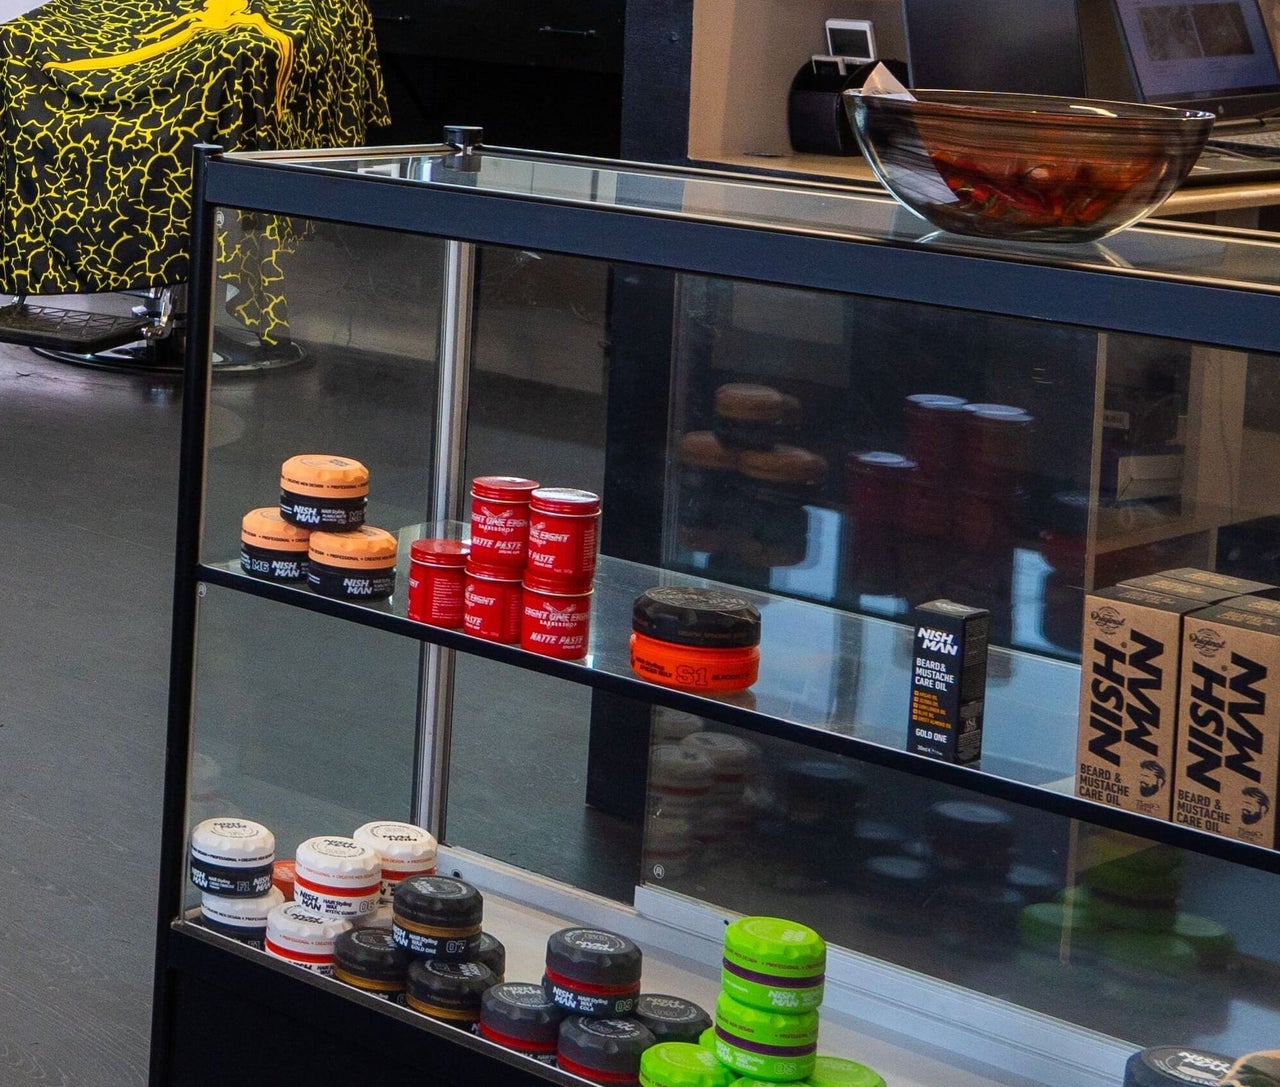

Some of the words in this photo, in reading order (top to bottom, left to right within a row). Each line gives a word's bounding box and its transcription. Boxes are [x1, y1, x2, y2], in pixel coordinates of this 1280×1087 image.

[293, 505, 317, 515] NISH
[296, 514, 320, 524] MAN
[486, 517, 506, 527] ONE
[540, 531, 570, 542] EIGHT
[495, 540, 521, 550] PASTE
[271, 560, 297, 571] NISH
[532, 552, 556, 564] PASTE
[275, 569, 300, 577] MAN
[344, 578, 369, 588] NISH
[347, 585, 372, 595] MAN
[525, 606, 549, 620] EIGHT
[549, 613, 570, 622] ONE
[1091, 611, 1127, 626] Original
[539, 619, 577, 627] BARBERSHOP
[530, 632, 558, 644] MATTE
[558, 635, 584, 644] PASTE
[917, 627, 954, 644] NISH
[1189, 633, 1226, 649] Original
[922, 639, 958, 655] MAN
[916, 657, 940, 671] BEARD
[940, 664, 946, 672] &
[675, 665, 708, 687] S1
[916, 667, 954, 684] MUSTACHE
[915, 676, 934, 688] CARE
[935, 681, 947, 691] OIL
[1124, 629, 1164, 757] MAN
[1088, 638, 1126, 767] NISH
[1225, 651, 1267, 783] MAN
[1186, 662, 1227, 793] NISH
[915, 728, 932, 739] GOLD
[934, 734, 947, 743] ONE
[1080, 764, 1111, 780] BEARD
[1114, 772, 1121, 784] &
[1080, 775, 1129, 797] MUSTACHE
[1079, 786, 1103, 801] CARE
[1106, 792, 1121, 806] OIL
[1178, 789, 1211, 807] BEARD
[1215, 798, 1222, 810] &
[1177, 800, 1231, 825] MUSTACHE
[1176, 813, 1202, 829] CARE
[1205, 819, 1221, 833] OIL
[300, 890, 319, 902] NISH
[302, 900, 321, 911] MAN
[335, 900, 352, 908] Styling
[360, 900, 375, 912] 06
[446, 940, 466, 953] 07
[552, 986, 573, 999] NISH
[555, 995, 577, 1008] MAN
